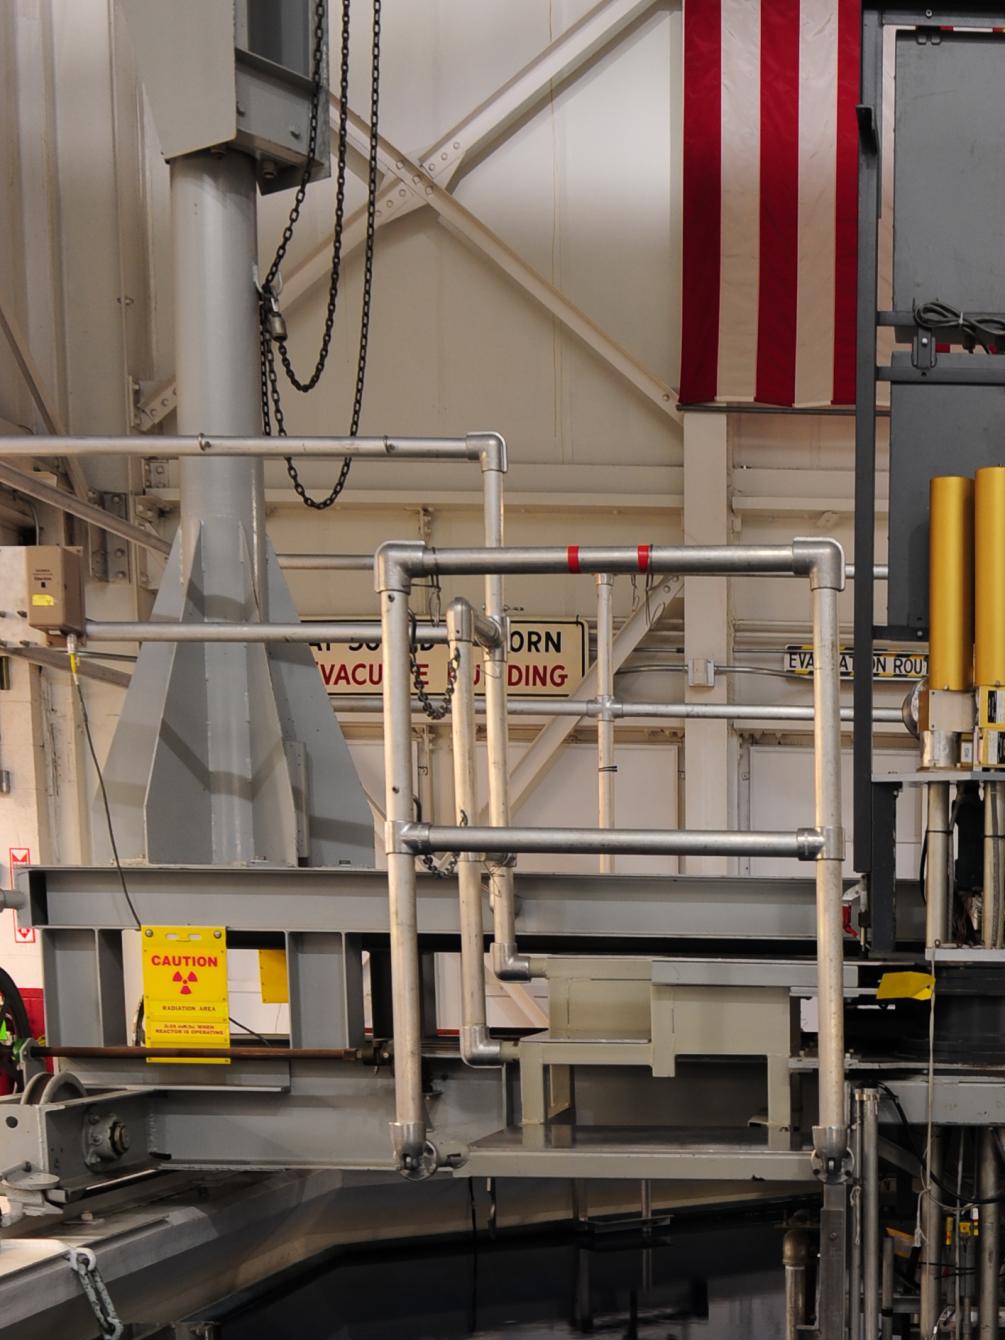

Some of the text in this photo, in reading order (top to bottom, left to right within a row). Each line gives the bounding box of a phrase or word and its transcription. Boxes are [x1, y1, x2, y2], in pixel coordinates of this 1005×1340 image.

[314, 661, 430, 687] VACUE
[893, 656, 929, 675] ROUT
[151, 955, 218, 967] CAUTION
